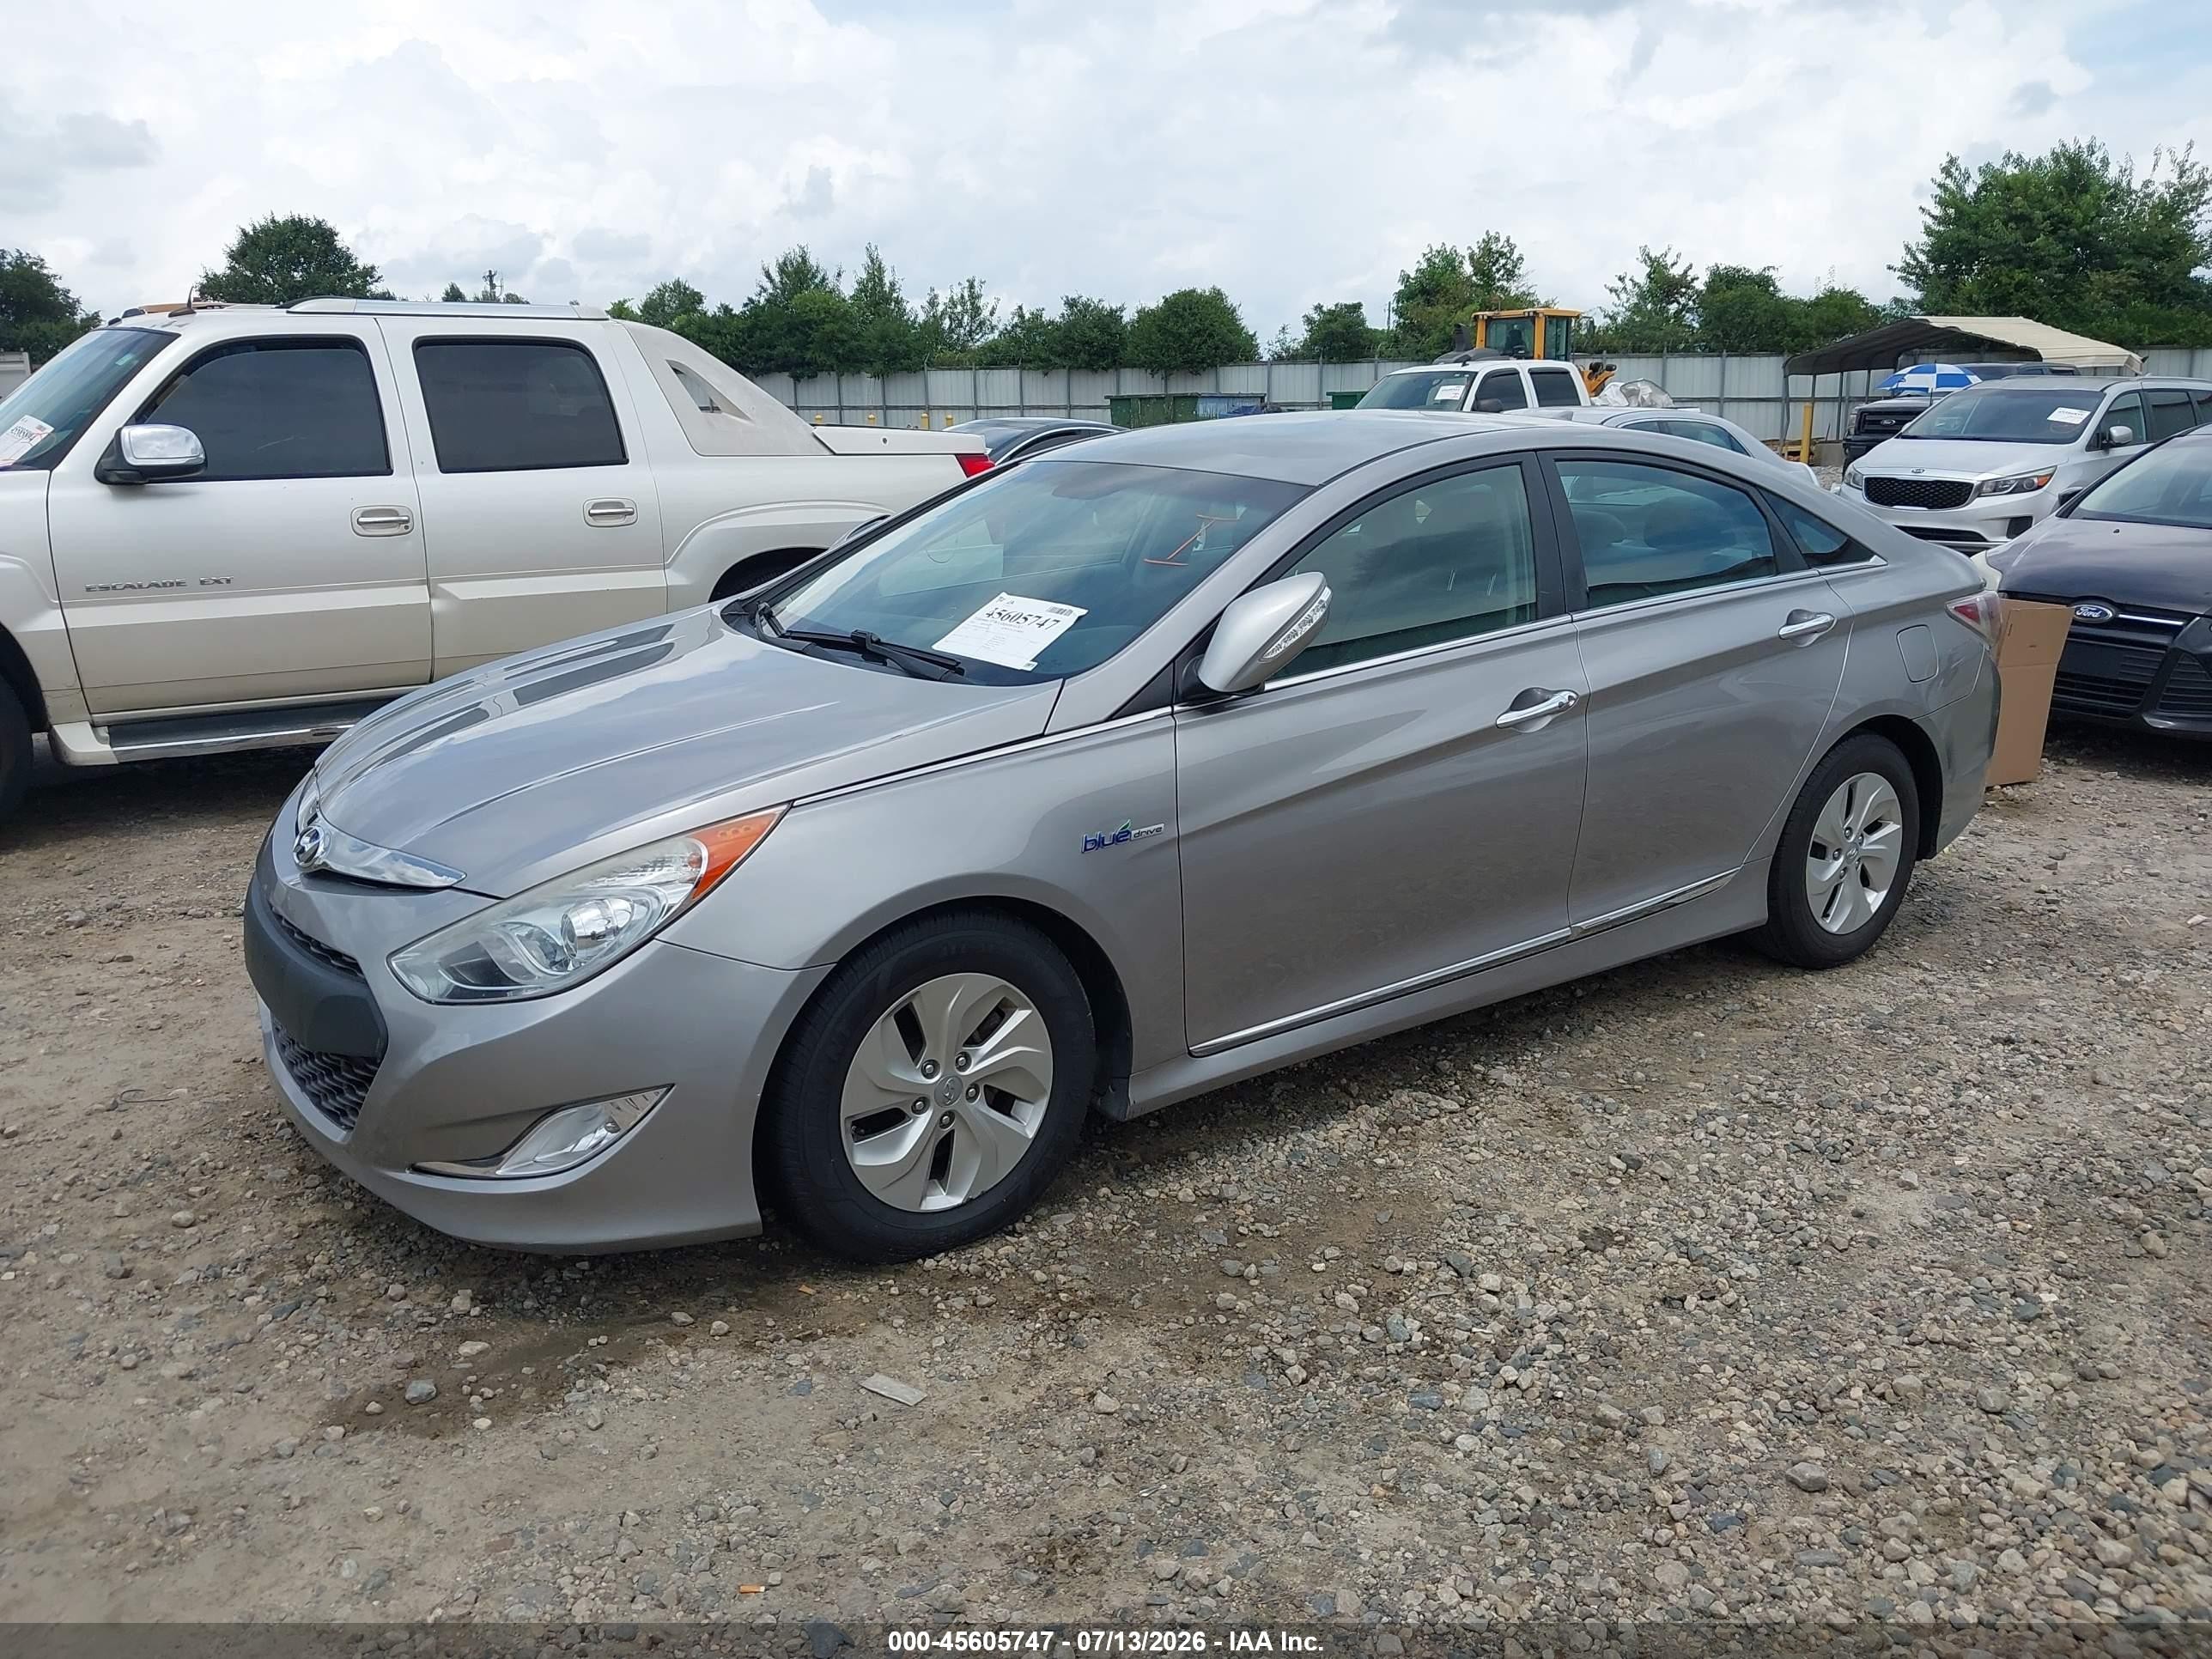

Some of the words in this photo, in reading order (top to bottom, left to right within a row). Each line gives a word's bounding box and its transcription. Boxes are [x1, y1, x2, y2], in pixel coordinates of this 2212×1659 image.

[85, 579, 187, 592] ESCALADE
[199, 576, 234, 586] EXT
[985, 607, 1060, 630] 45605747
[2075, 606, 2102, 617] Ford
[1133, 826, 1163, 838] drive
